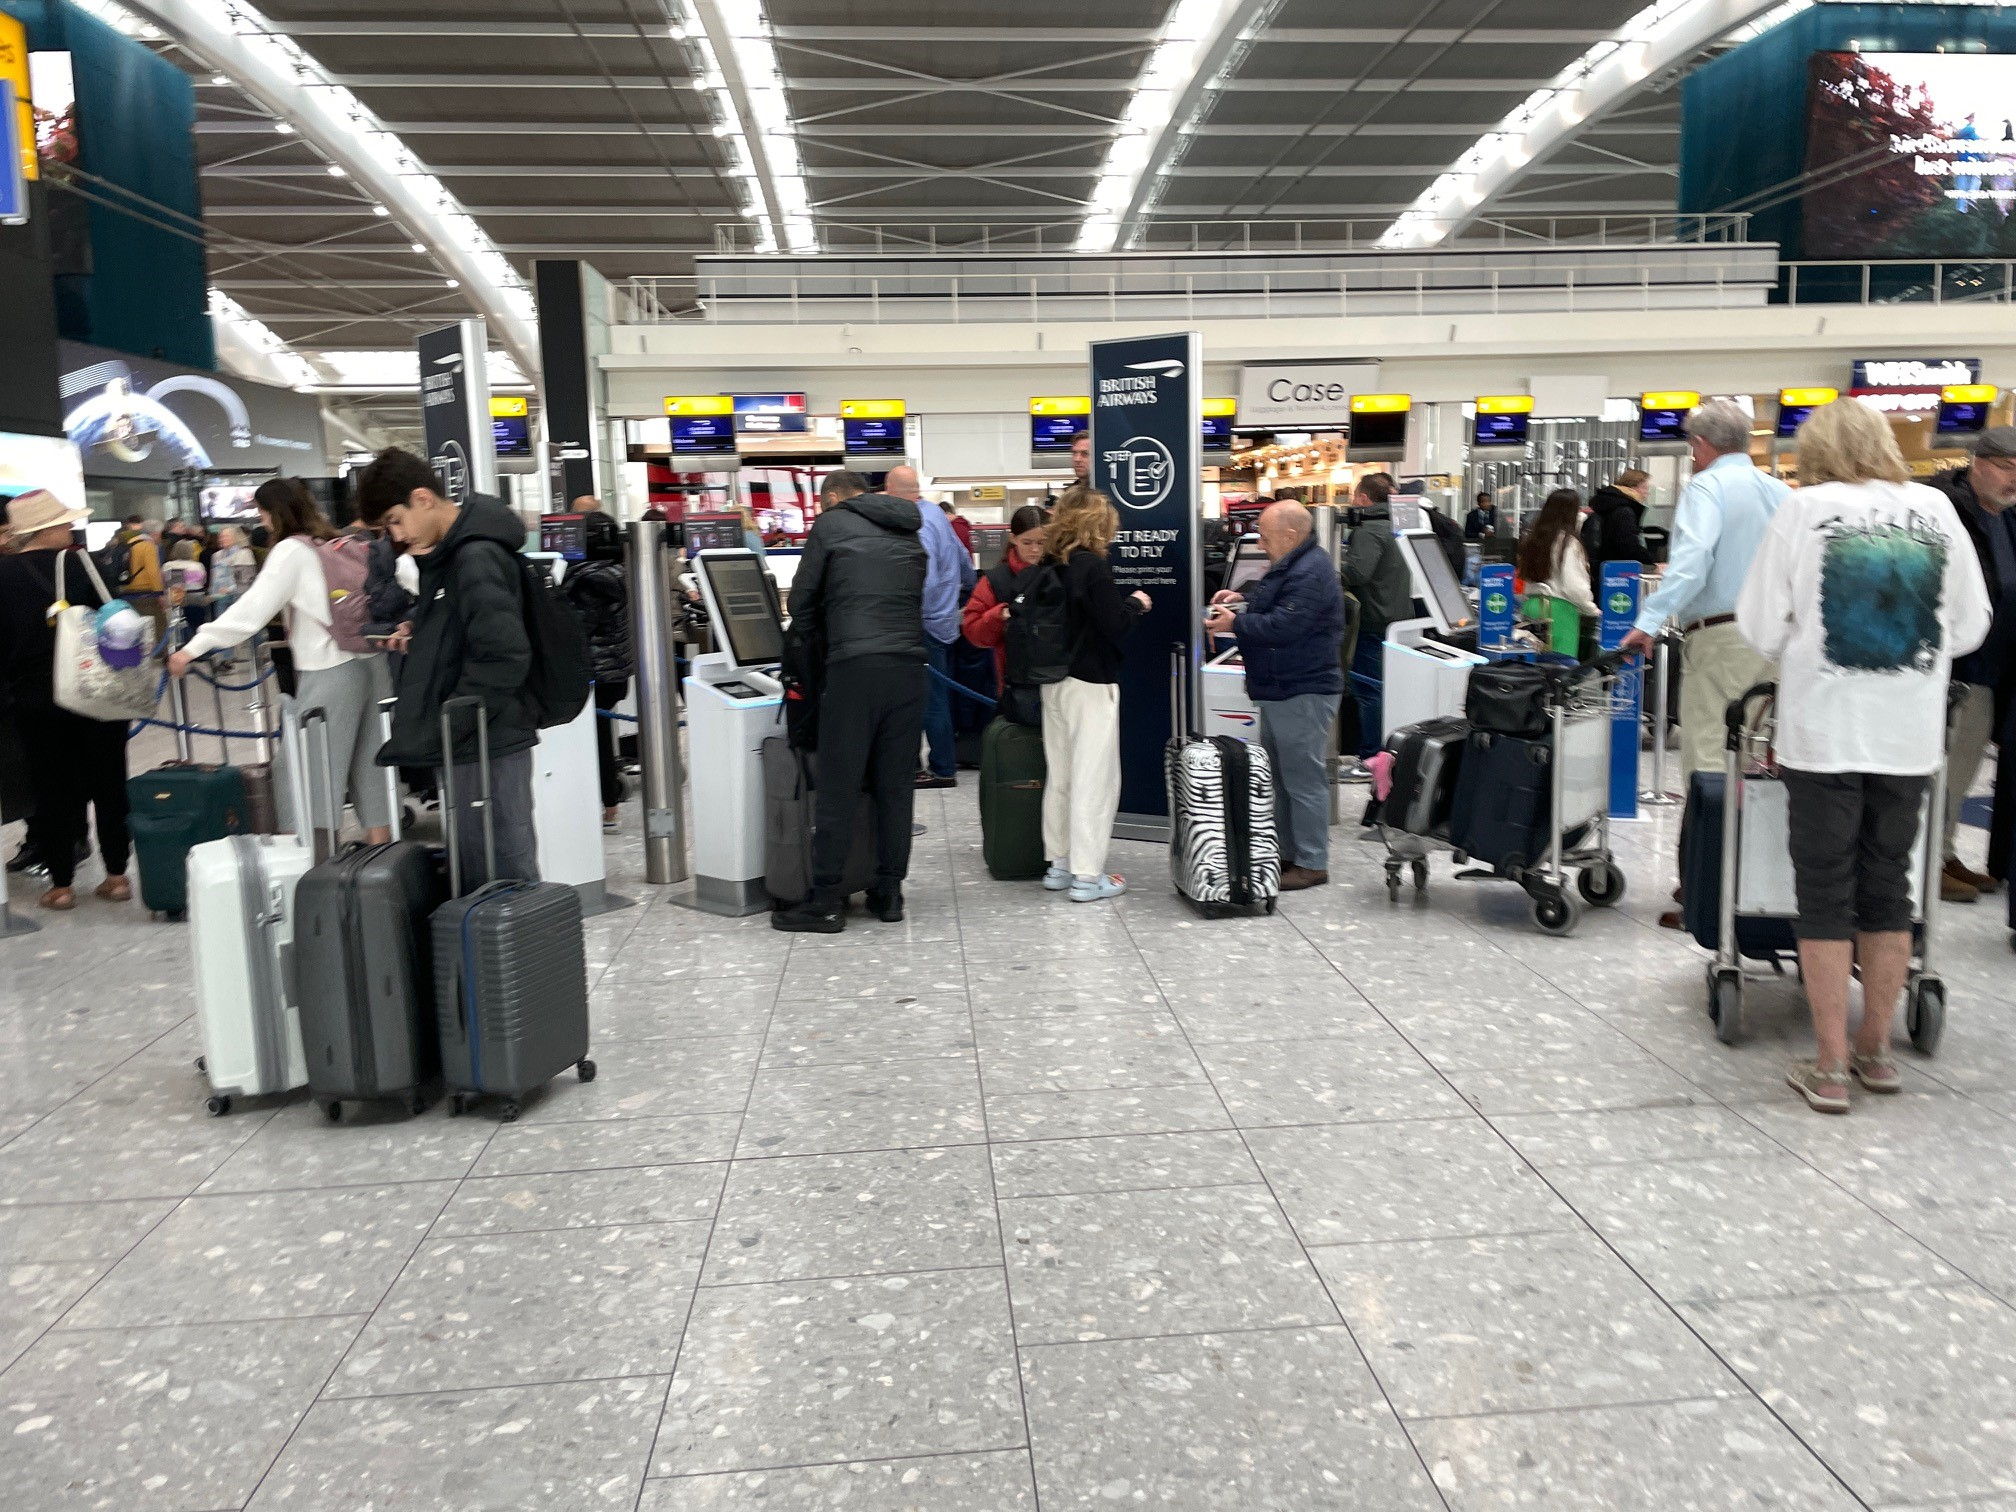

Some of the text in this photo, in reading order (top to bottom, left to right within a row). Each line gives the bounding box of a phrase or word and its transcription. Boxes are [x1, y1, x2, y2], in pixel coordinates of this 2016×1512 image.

[1100, 375, 1156, 392] BRITISH
[1267, 378, 1345, 402] Case
[1097, 391, 1158, 407] AIRWAYS
[1102, 450, 1132, 462] STEP
[1107, 462, 1118, 480] 1
[1109, 529, 1180, 543] ET READY
[1118, 545, 1166, 558] TO FLY
